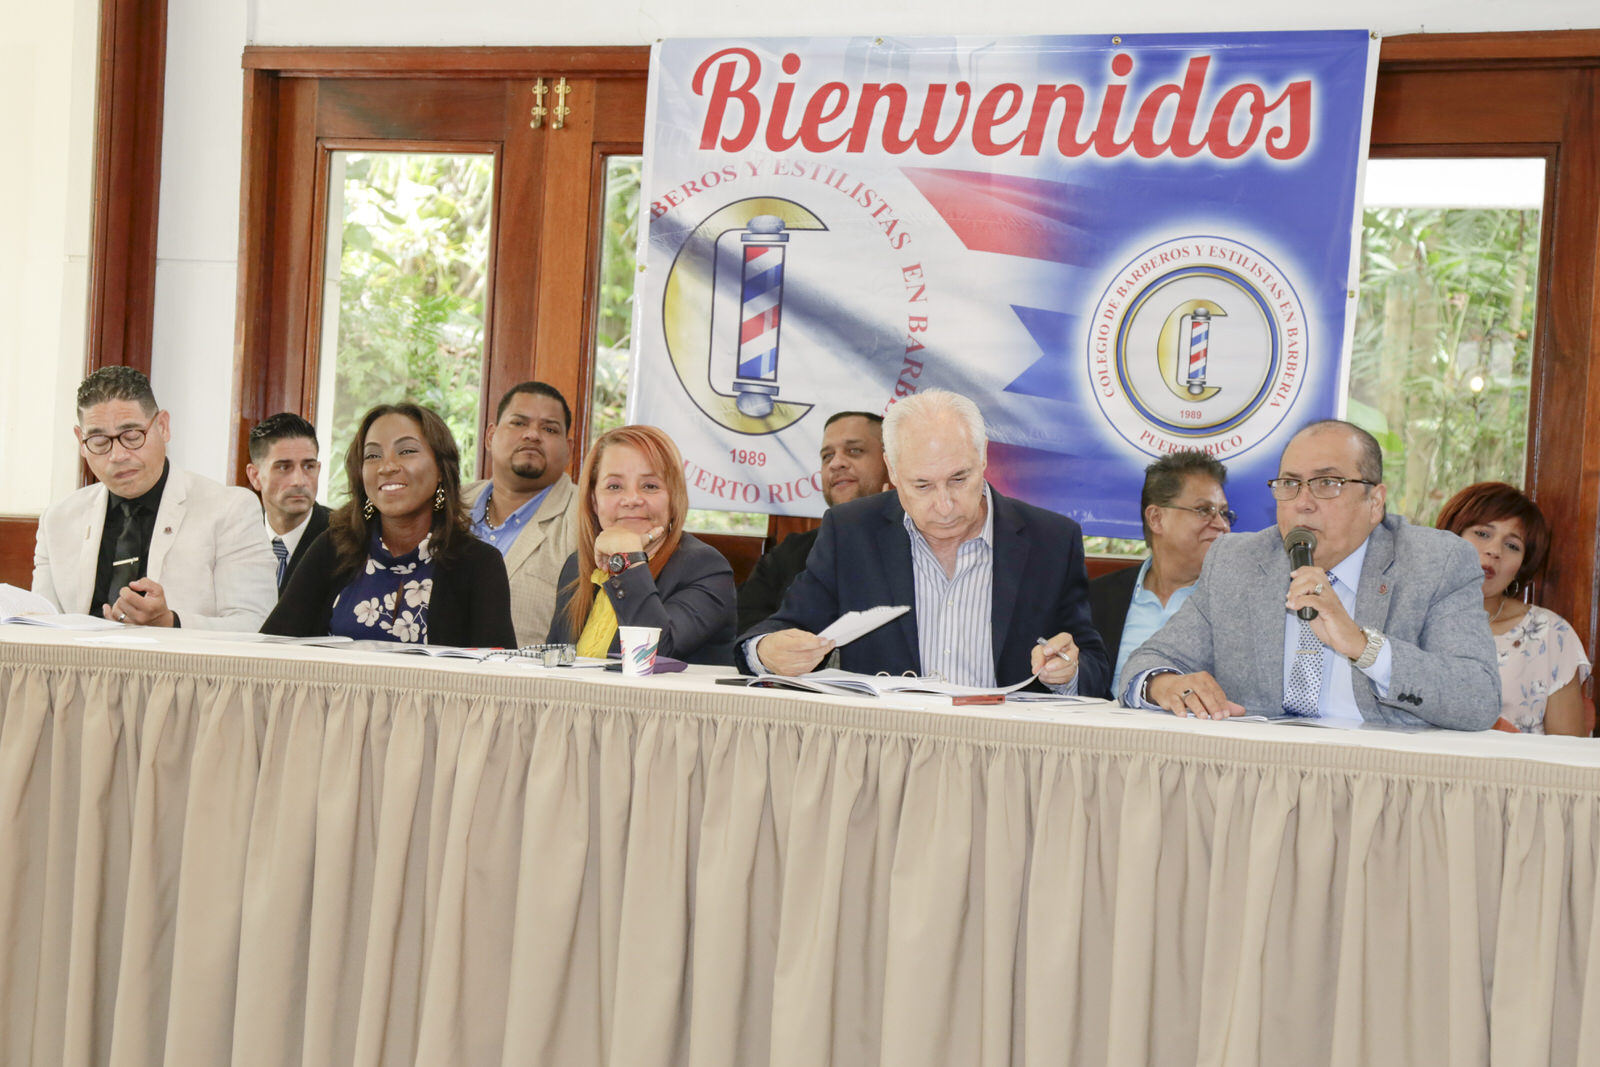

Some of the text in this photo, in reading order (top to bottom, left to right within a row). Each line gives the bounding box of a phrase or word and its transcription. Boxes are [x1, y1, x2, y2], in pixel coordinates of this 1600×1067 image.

[691, 47, 1312, 161] Bienvenidos
[650, 157, 928, 418] BEROS Y ESTILISTAS EN BARB
[1096, 245, 1299, 408] COLEGIO DE BARBEROS Y ESTILISTAS EN BARBERIA
[1180, 409, 1203, 420] 1989
[729, 448, 767, 467] 1989
[1203, 434, 1243, 457] RICO
[683, 459, 761, 504] UERTO
